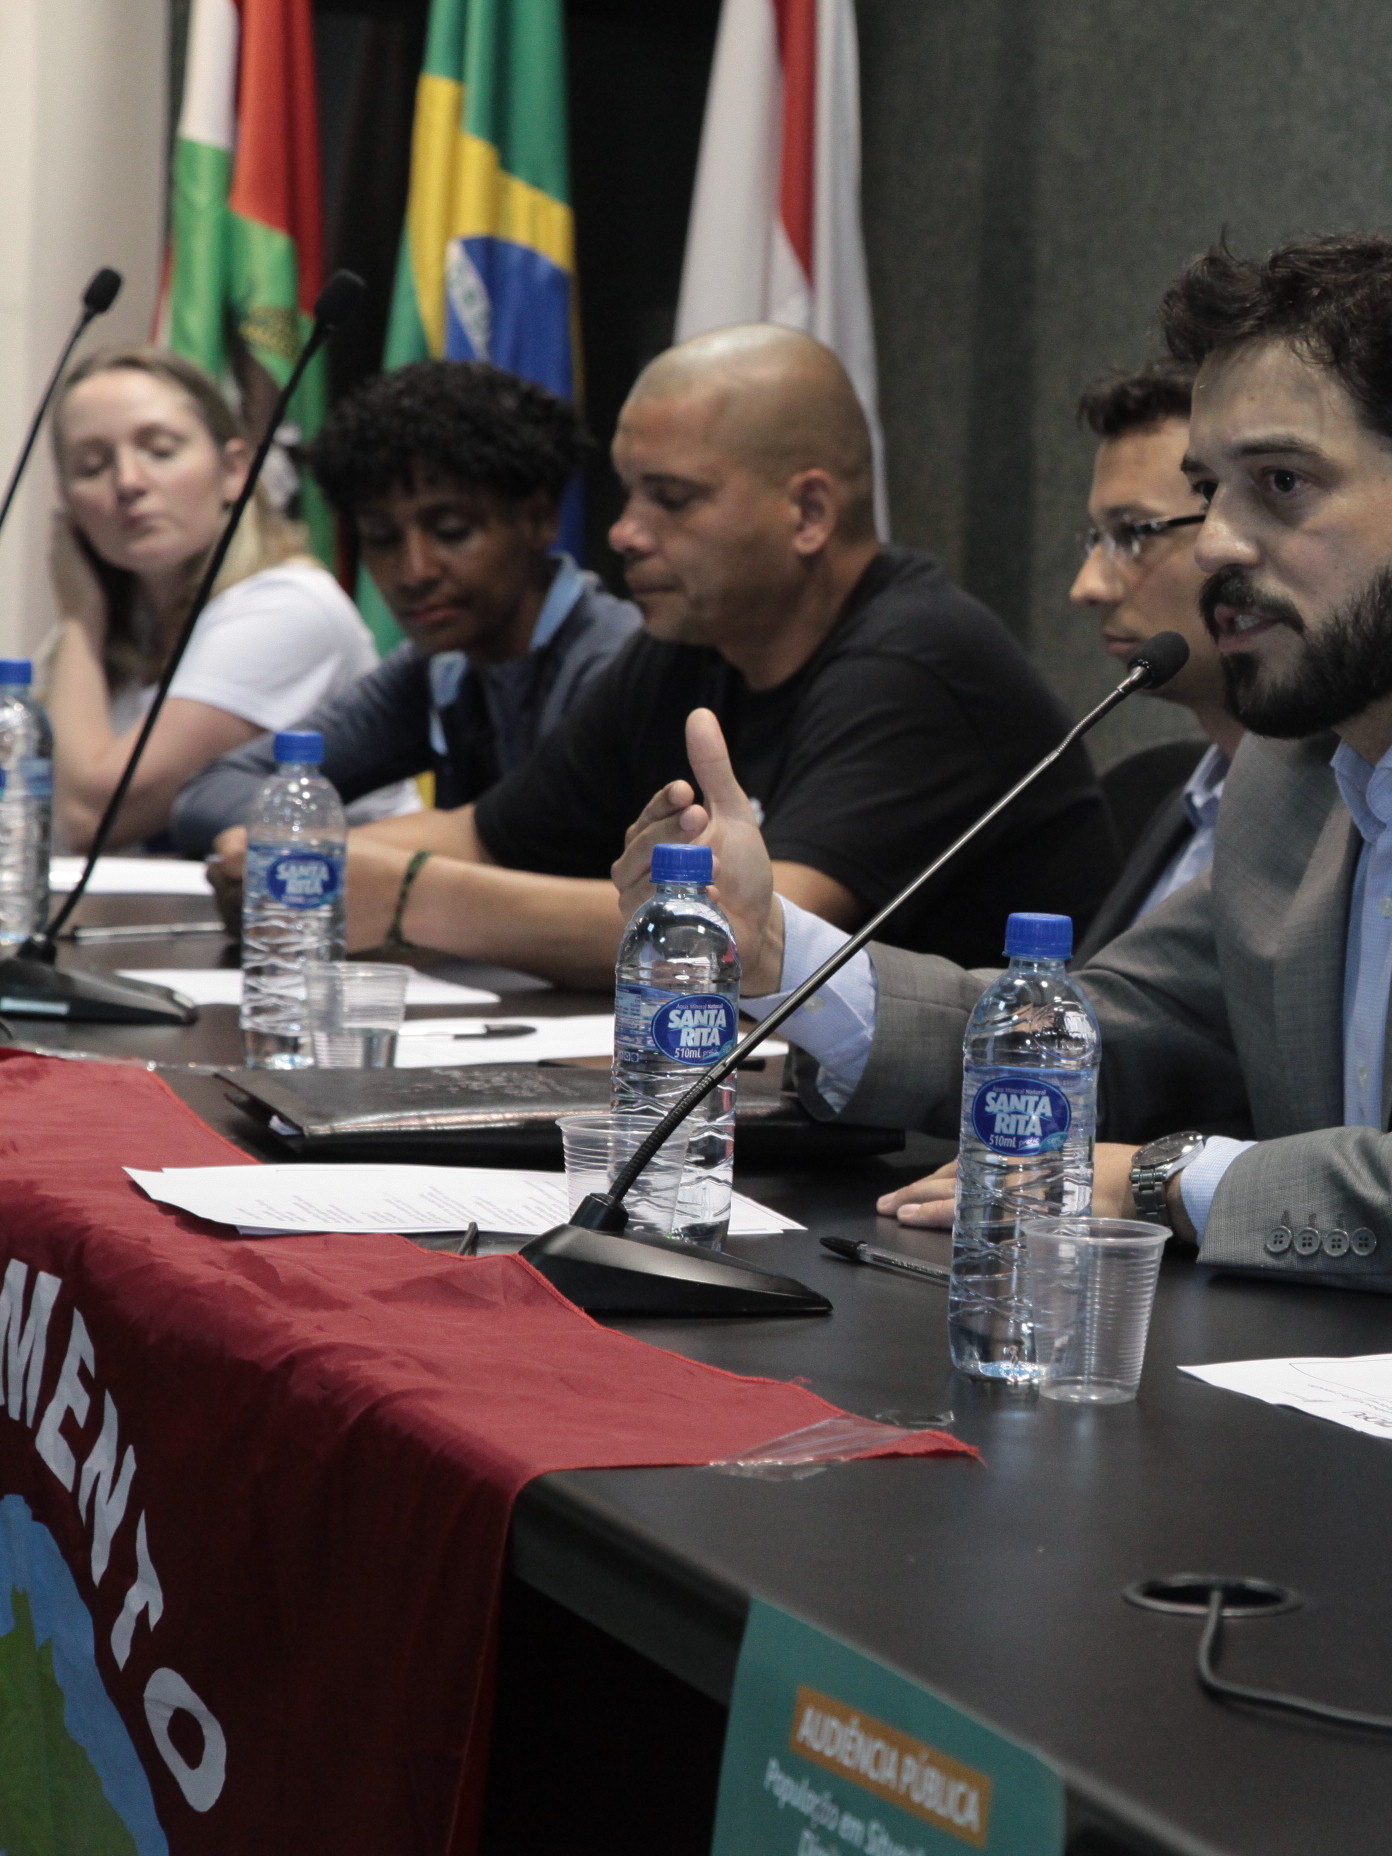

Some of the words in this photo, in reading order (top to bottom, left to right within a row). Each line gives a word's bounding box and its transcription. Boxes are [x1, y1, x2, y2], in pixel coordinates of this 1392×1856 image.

[275, 862, 330, 881] SANTA
[286, 879, 324, 895] RITA
[668, 1009, 727, 1029] SANTA
[680, 1027, 721, 1047] RITA
[985, 1091, 1053, 1117] SANTA
[994, 1113, 1043, 1137] RITA
[796, 1705, 900, 1791] AUDIÊNCIA
[898, 1750, 982, 1834] PÚBLICA
[763, 1756, 840, 1832] População
